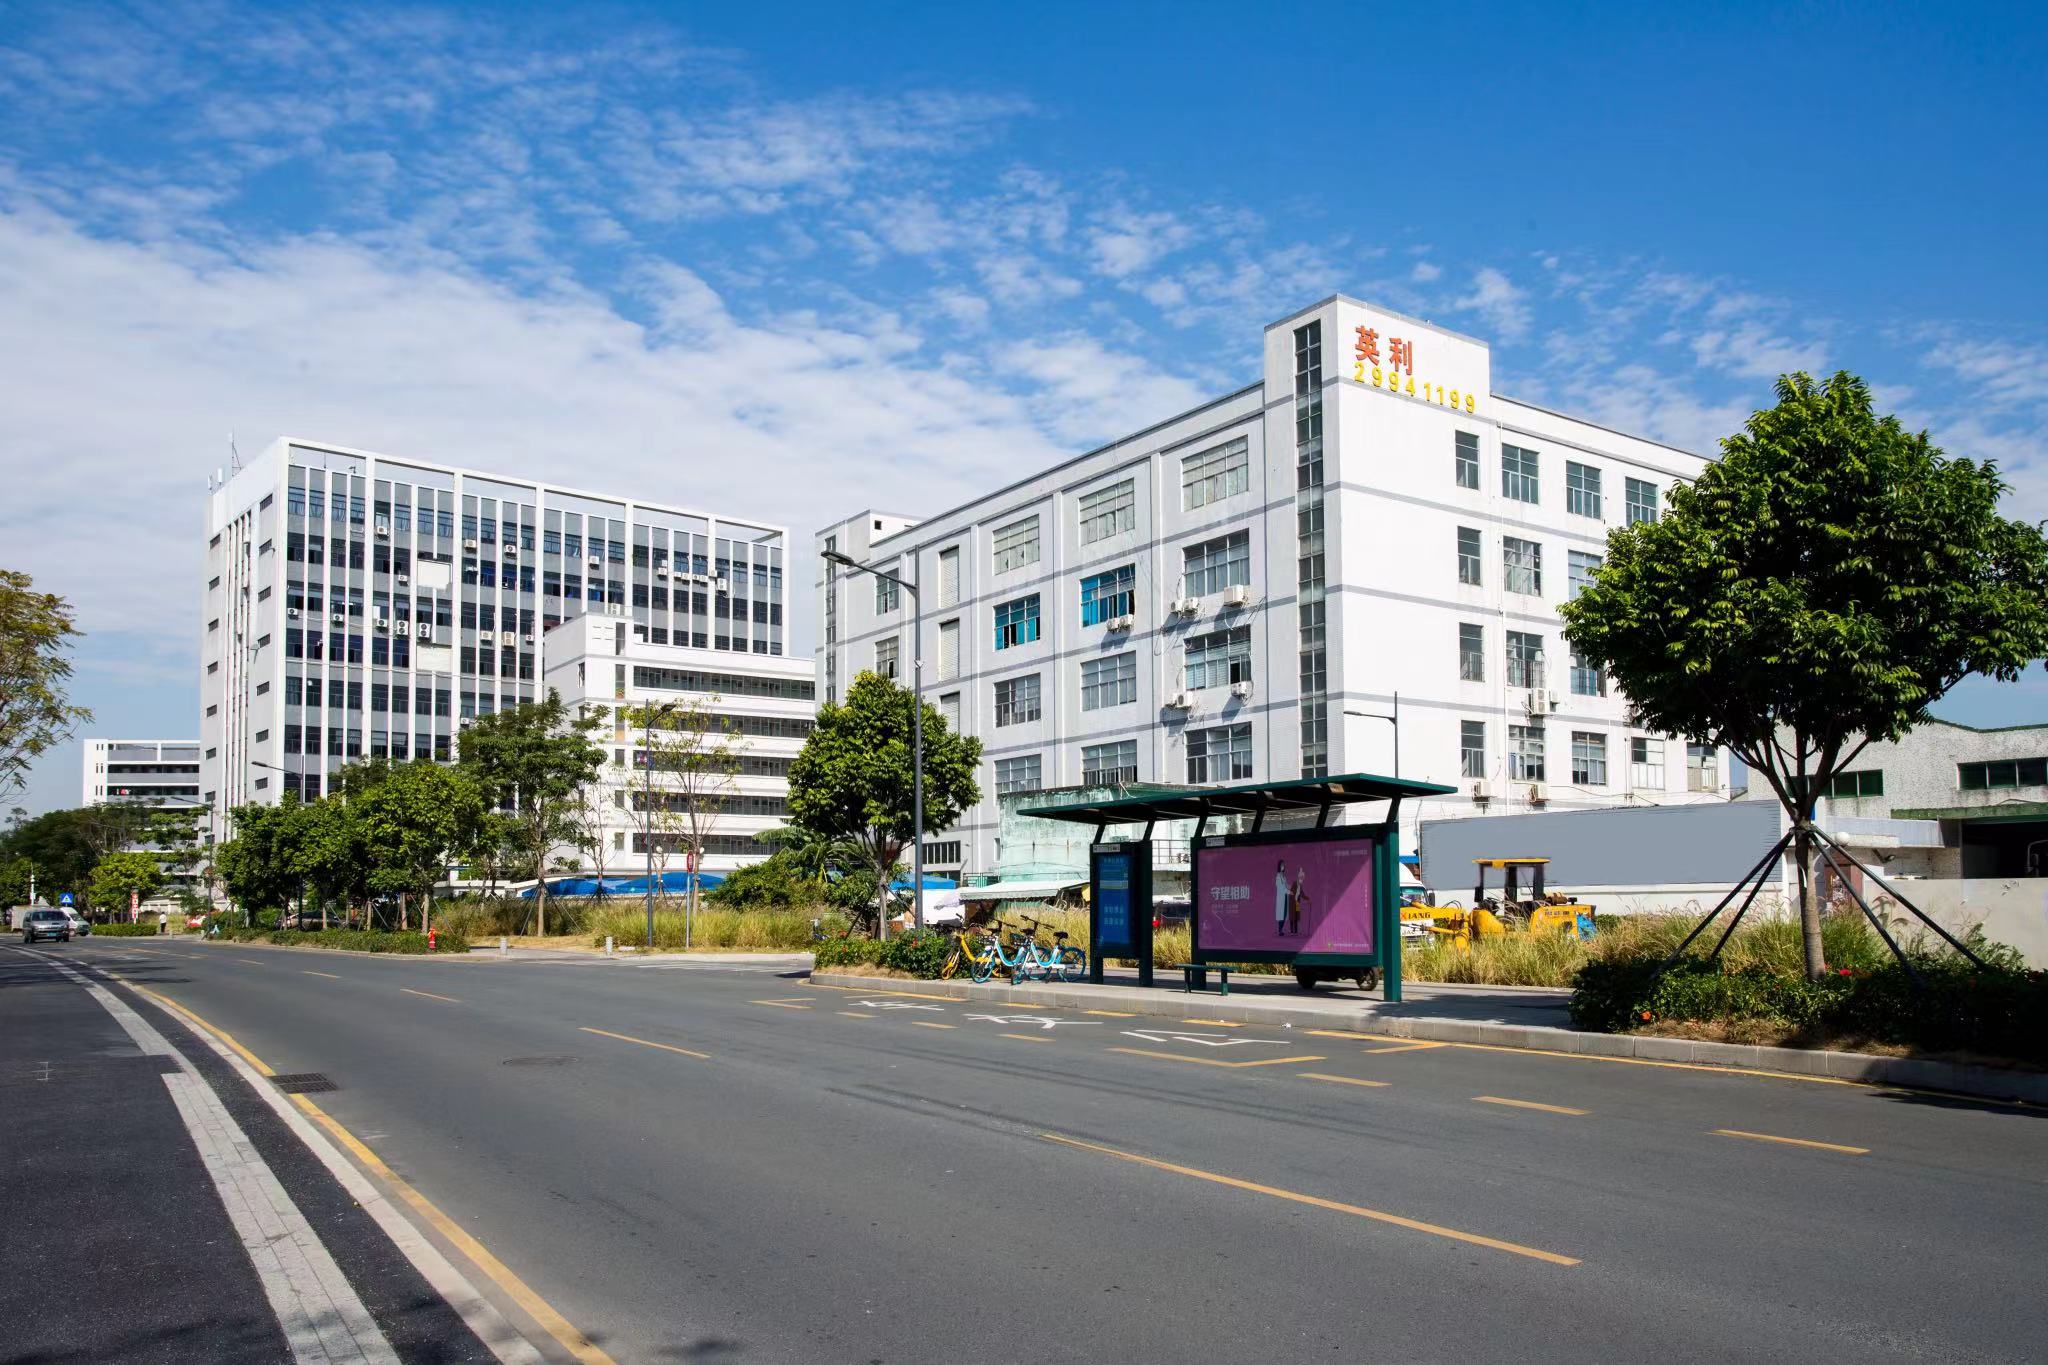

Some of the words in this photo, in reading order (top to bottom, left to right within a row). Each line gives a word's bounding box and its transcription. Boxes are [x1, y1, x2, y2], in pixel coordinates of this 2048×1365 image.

[1355, 326, 1413, 375] 英利
[1354, 361, 1475, 413] 29941199
[1210, 886, 1249, 900] 守望相助
